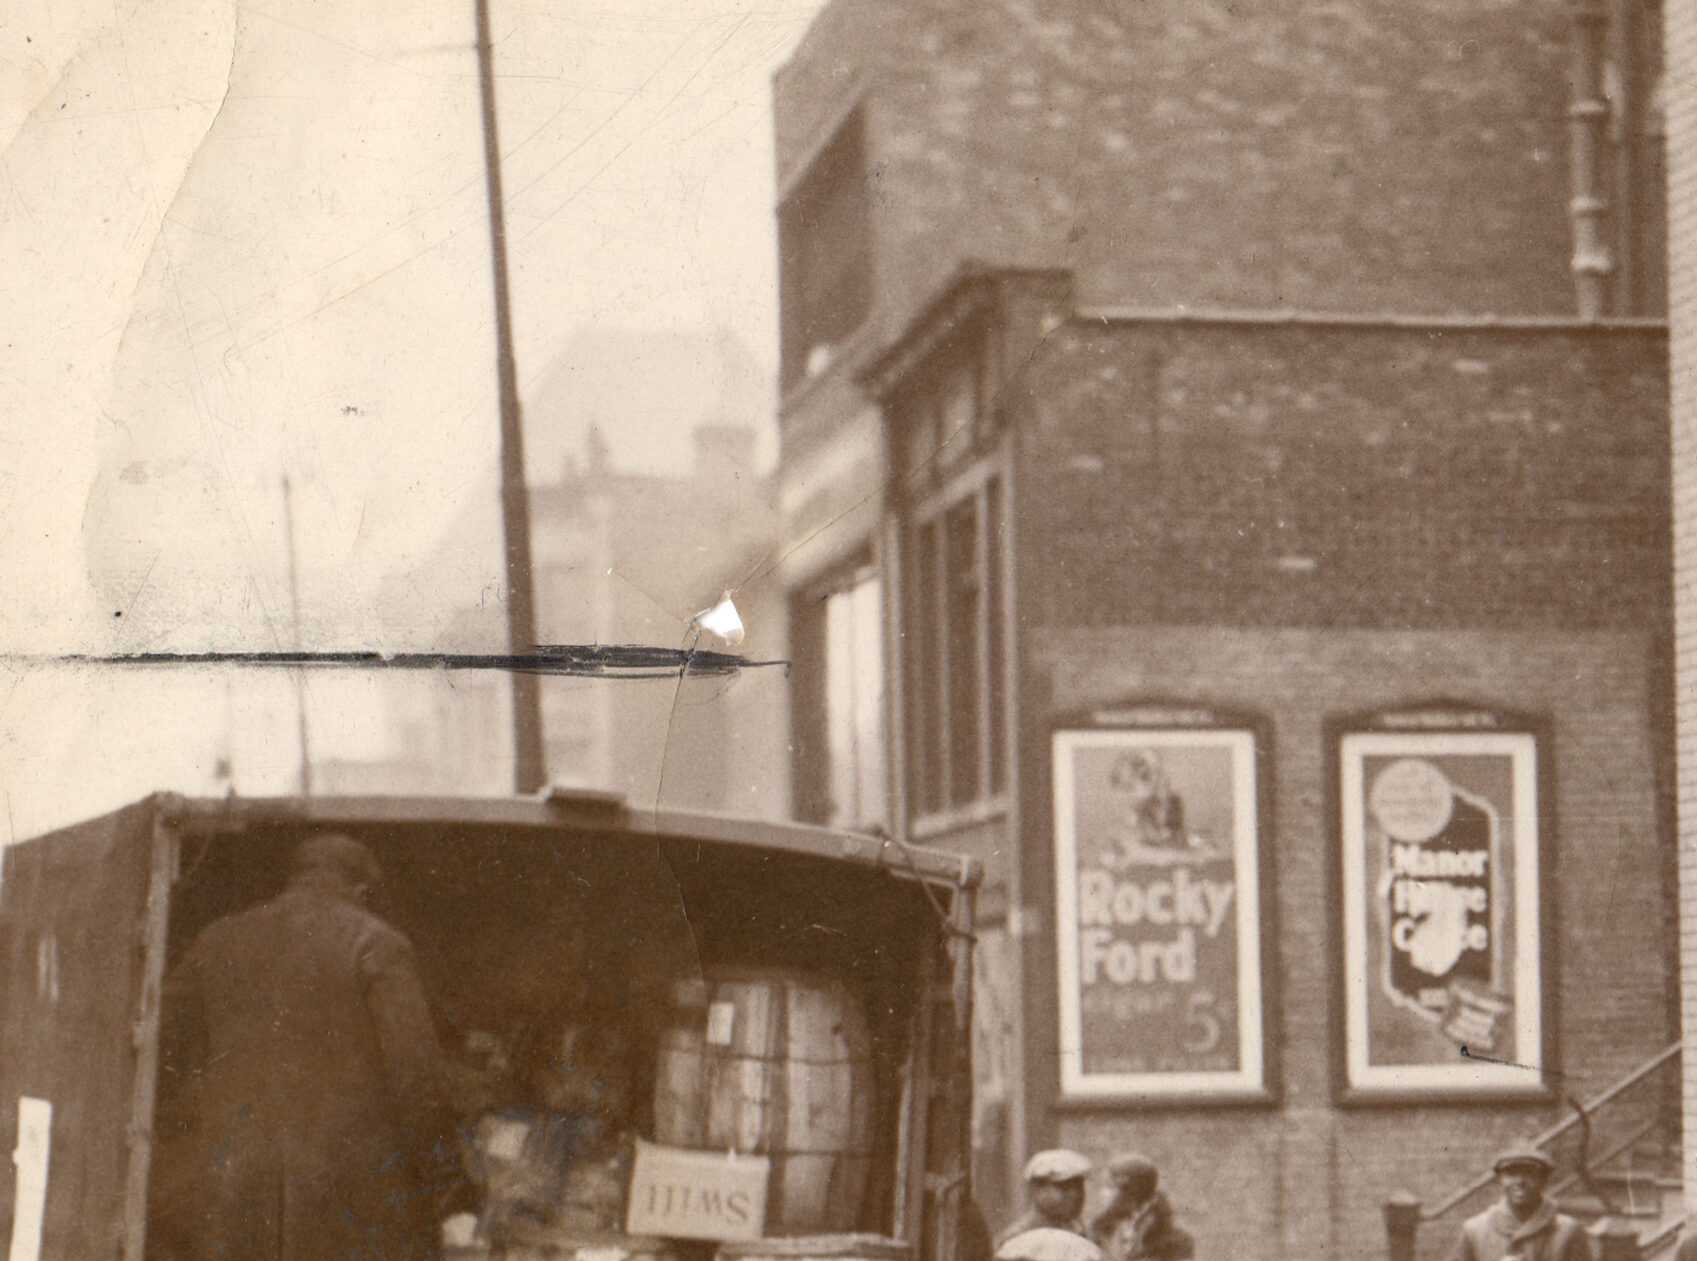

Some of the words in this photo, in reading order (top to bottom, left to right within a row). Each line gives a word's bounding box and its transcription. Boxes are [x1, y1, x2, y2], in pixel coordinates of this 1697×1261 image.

[1392, 844, 1489, 878] Manor
[1079, 868, 1235, 938] Rocky
[1079, 926, 1197, 985] Ford
